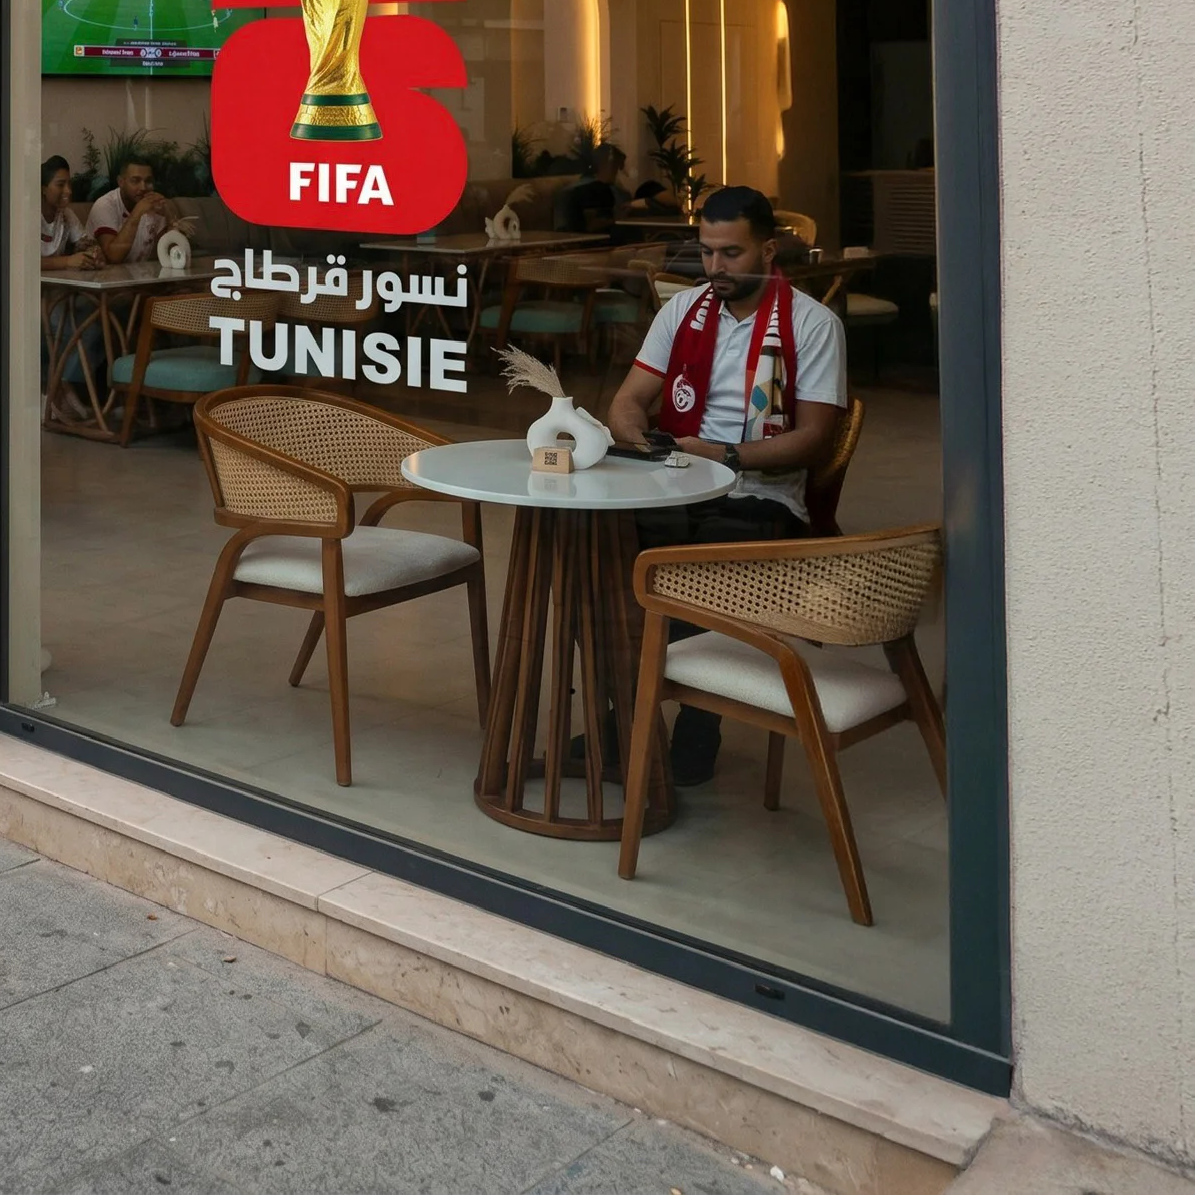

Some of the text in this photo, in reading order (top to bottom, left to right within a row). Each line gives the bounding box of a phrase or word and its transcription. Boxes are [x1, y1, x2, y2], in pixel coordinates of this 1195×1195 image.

[289, 161, 395, 207] FIFA
[210, 248, 468, 313] نسور قرطاج
[209, 316, 468, 393] TUNISIE
